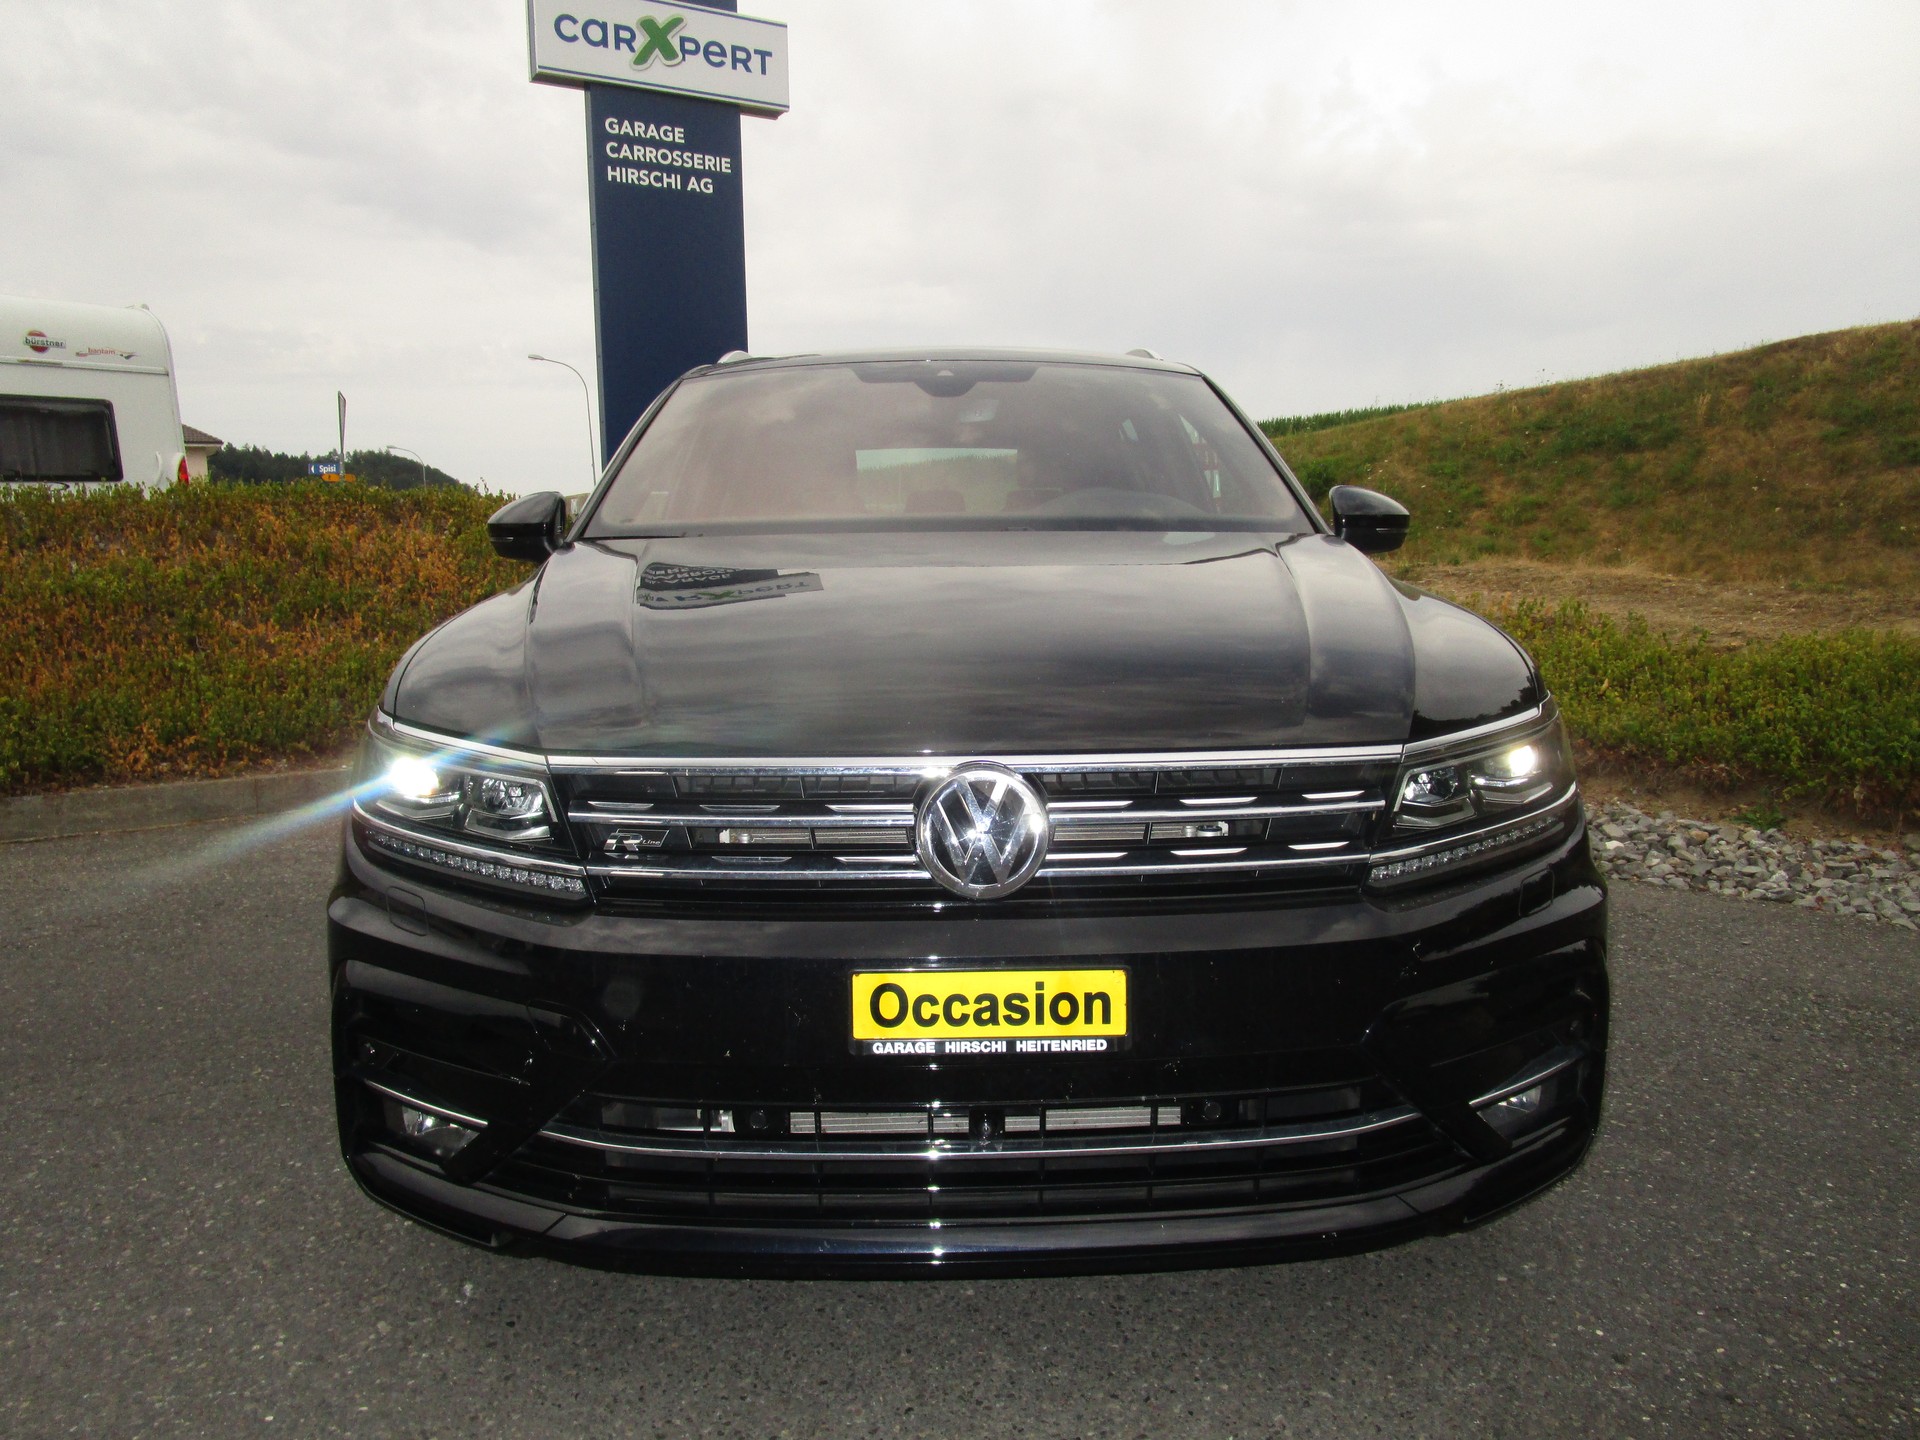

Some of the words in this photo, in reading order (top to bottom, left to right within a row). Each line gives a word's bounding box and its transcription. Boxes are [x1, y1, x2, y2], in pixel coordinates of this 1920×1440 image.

[605, 117, 685, 143] GARAGE
[605, 142, 731, 173] CARROSSERIE
[607, 166, 681, 190] HIRSCHI
[687, 177, 714, 194] AG
[319, 464, 337, 474] Spisi
[604, 832, 643, 851] R
[869, 981, 1112, 1028] Occasion
[872, 1041, 936, 1055] GARAGE
[945, 1040, 1007, 1054] HIRSCHI
[1016, 1038, 1108, 1053] HEITENRIED
